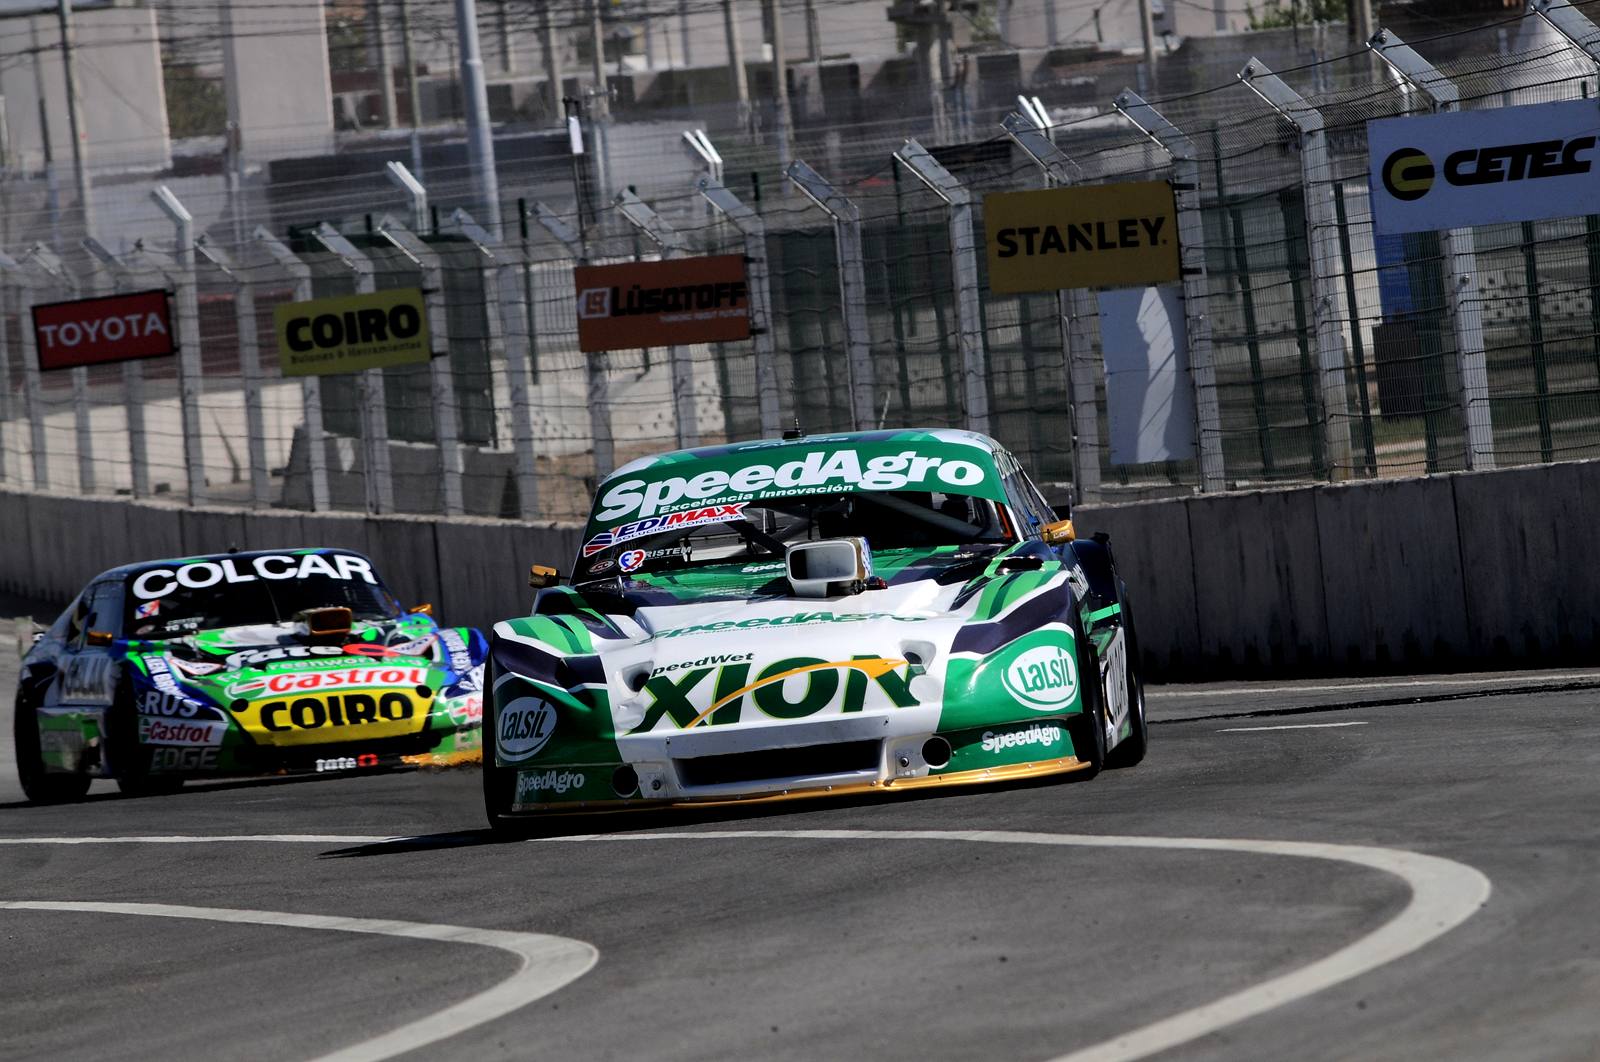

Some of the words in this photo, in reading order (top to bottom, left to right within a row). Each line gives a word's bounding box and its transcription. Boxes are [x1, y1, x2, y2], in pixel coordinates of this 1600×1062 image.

[1443, 136, 1596, 186] CETEC
[996, 216, 1165, 258] STANLEY
[40, 312, 166, 348] TOYOTA
[286, 304, 420, 352] COIRO
[596, 450, 985, 521] SpeedAgro
[658, 493, 754, 514] Excelencia
[759, 484, 853, 498] Innovación
[616, 502, 750, 538] EDIMAX
[133, 554, 378, 599] COLCAR
[633, 611, 927, 645] SpeedAgro
[268, 669, 424, 692] Castrol
[652, 652, 754, 678] peedWet
[260, 692, 414, 732] COIRO
[626, 655, 922, 735] XION
[151, 721, 213, 743] Castrol
[981, 724, 1061, 753] SpeedAgro
[151, 747, 221, 771] EDGE
[519, 770, 585, 796] SpeedAgro
